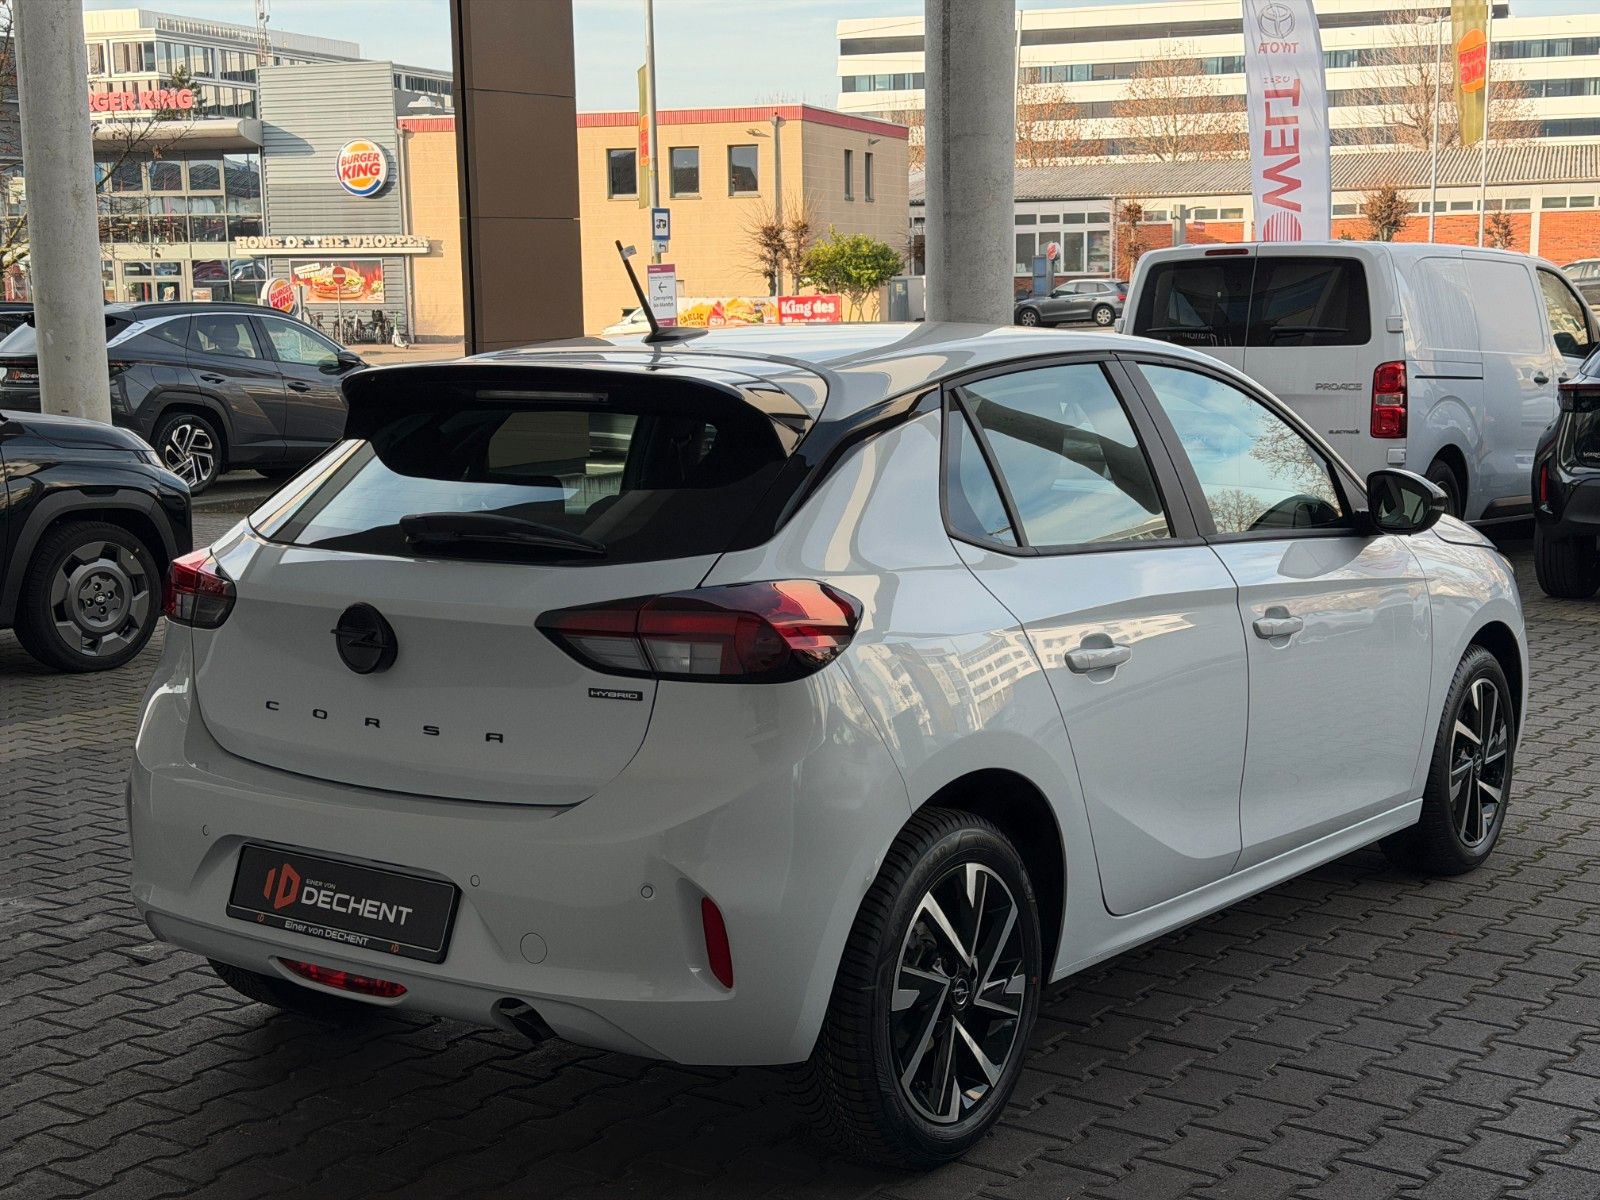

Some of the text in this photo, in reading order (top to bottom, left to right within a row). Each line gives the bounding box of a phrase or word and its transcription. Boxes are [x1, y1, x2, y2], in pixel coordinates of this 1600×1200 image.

[90, 89, 193, 111] GER KING
[341, 152, 380, 167] BURGER
[342, 162, 381, 180] KING
[235, 235, 429, 249] HOME OF THE WHOPPER
[272, 291, 294, 308] KING
[781, 300, 835, 317] King des
[590, 690, 638, 699] HYBRID
[265, 700, 504, 743] CORSA
[305, 878, 337, 890] EINER VON
[301, 886, 413, 926] DECHENT
[284, 920, 370, 946] Einer von DECHENT
